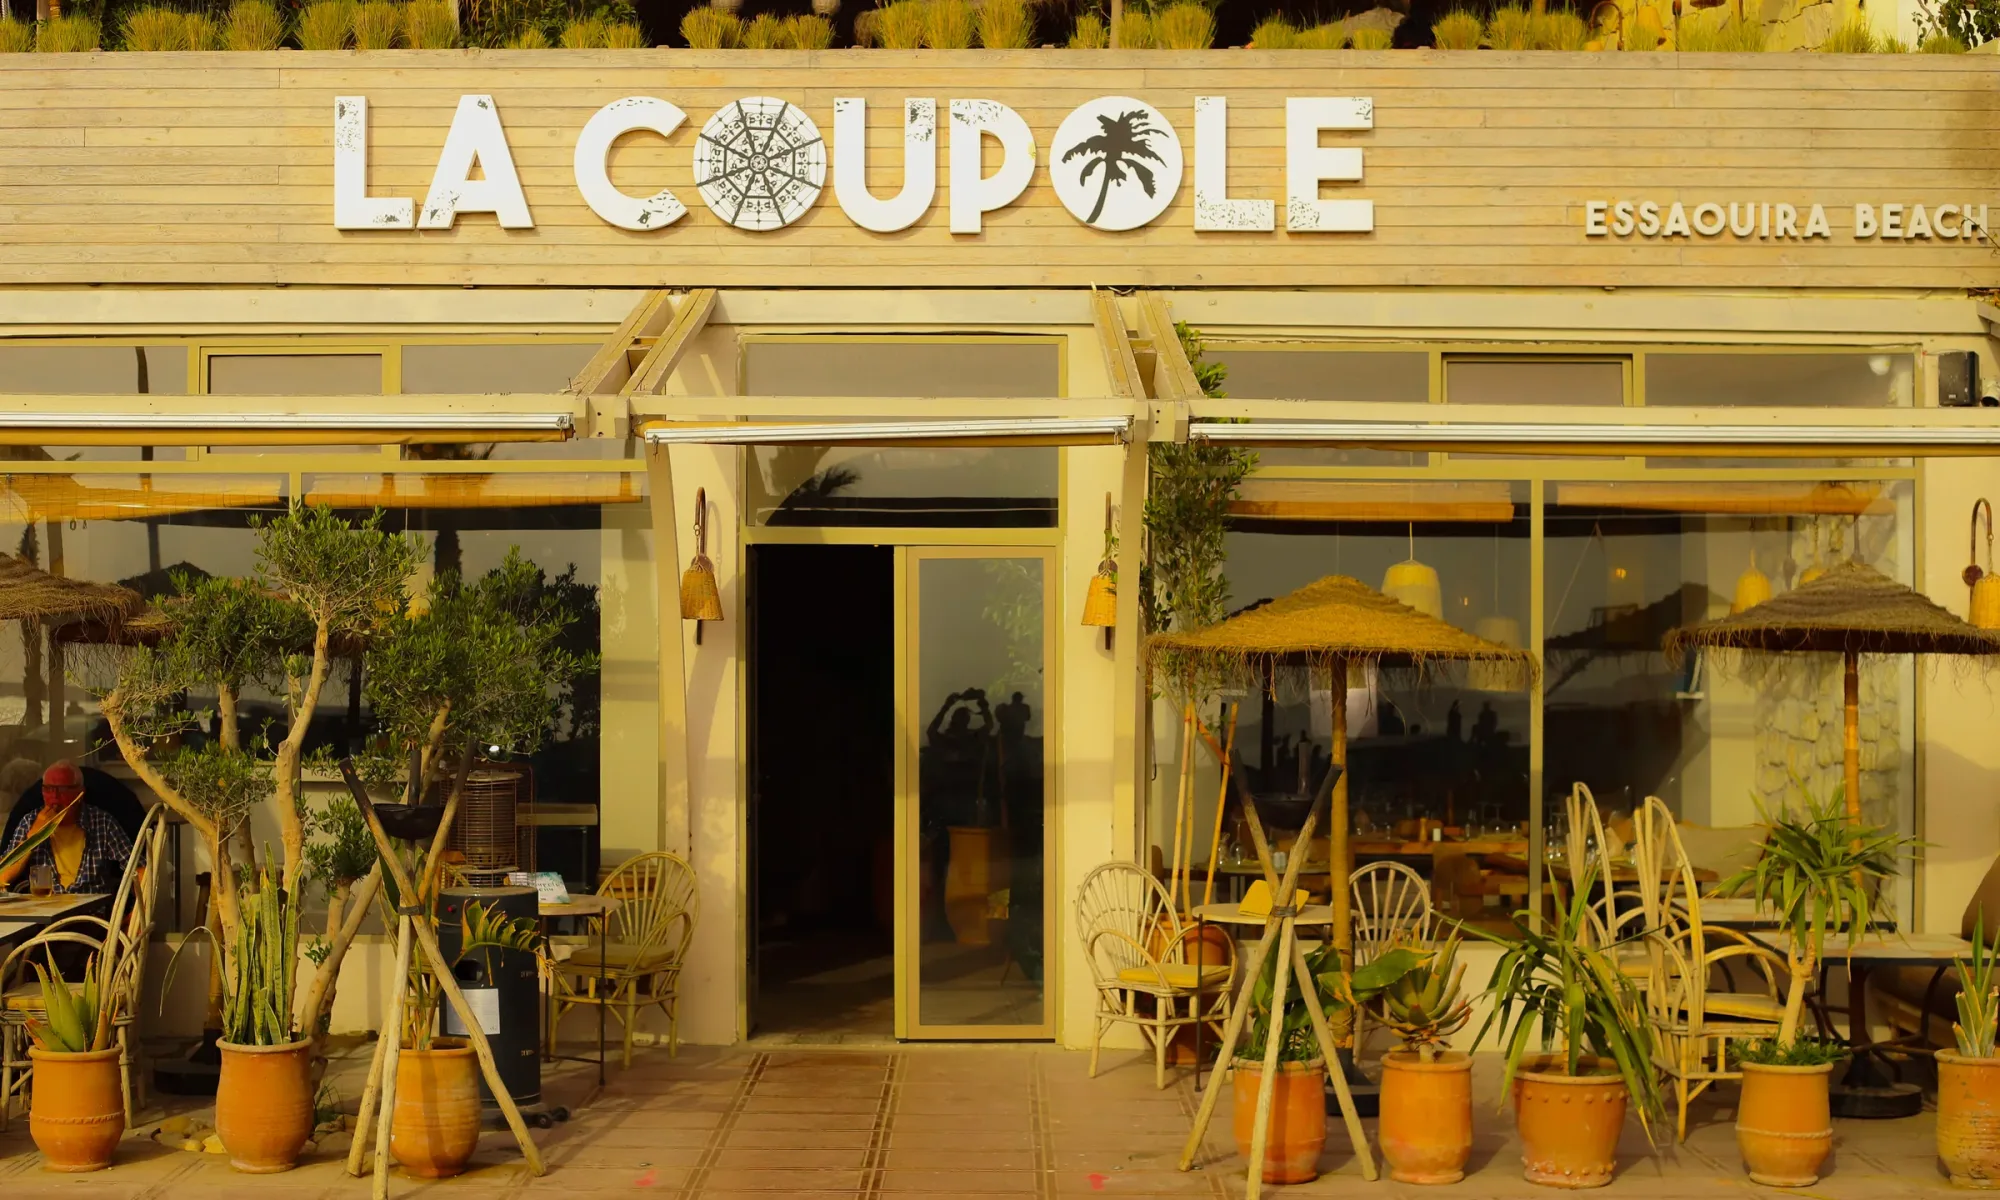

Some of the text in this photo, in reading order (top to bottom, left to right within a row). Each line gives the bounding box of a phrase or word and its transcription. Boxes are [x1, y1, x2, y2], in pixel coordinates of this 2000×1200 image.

[333, 94, 1375, 235] LA COUPOLE
[1585, 199, 1989, 241] ESSAOUIRA BEACH
